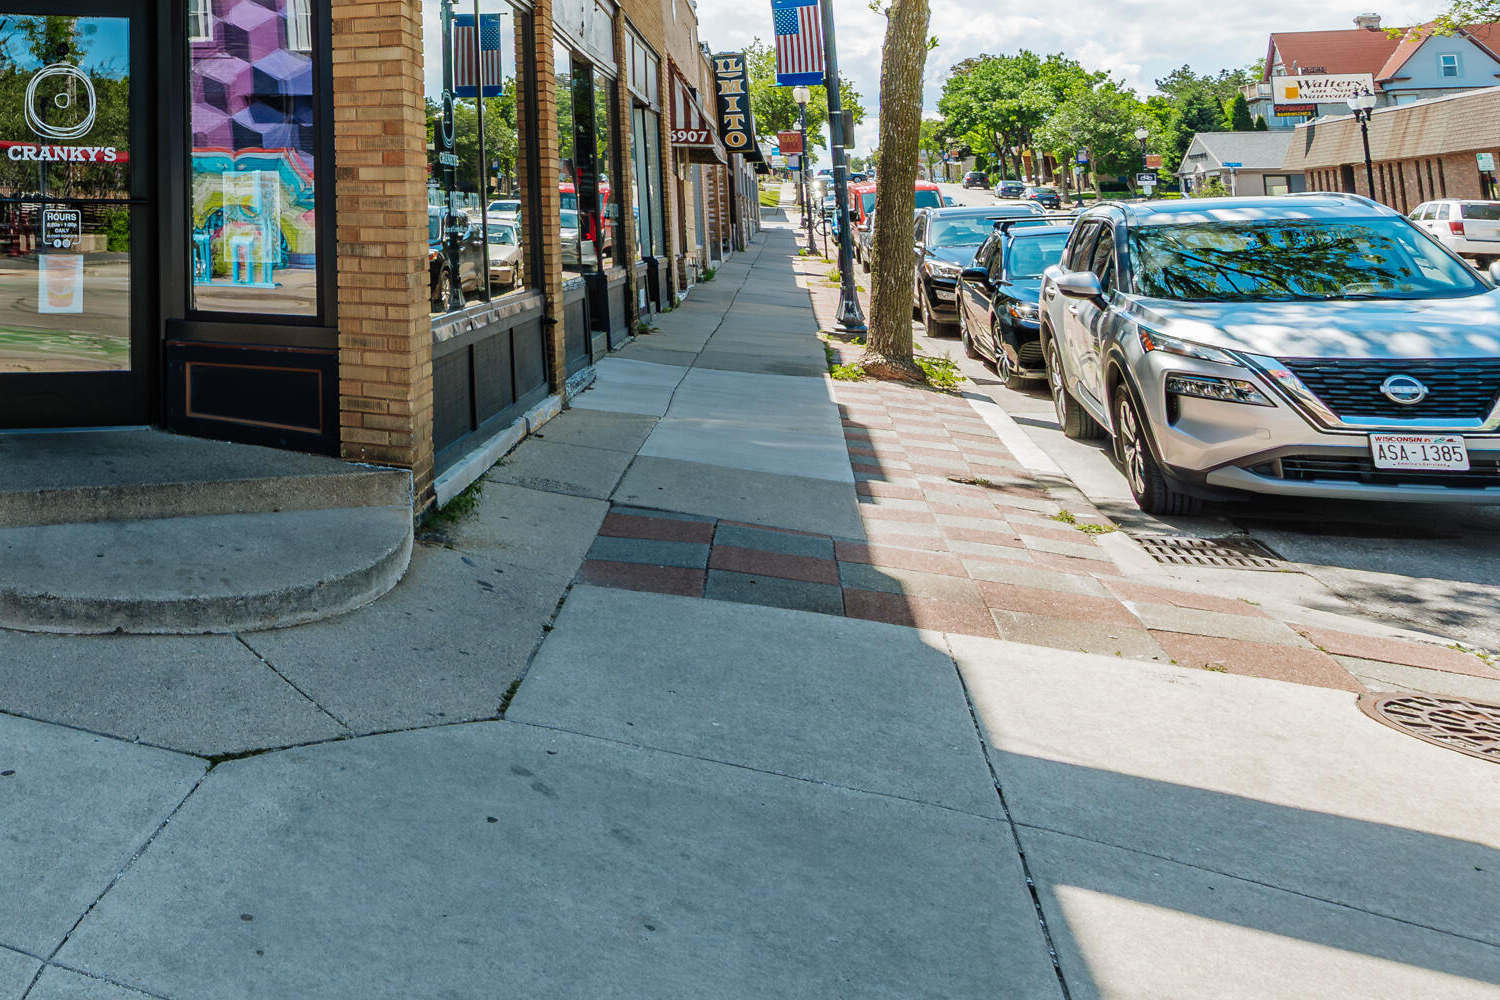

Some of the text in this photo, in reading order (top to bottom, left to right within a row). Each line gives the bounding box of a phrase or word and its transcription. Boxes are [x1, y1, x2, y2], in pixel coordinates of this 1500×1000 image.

[7, 145, 117, 162] CRANKY'S
[47, 213, 77, 221] HOURS
[1378, 444, 1464, 462] ASA-1385
